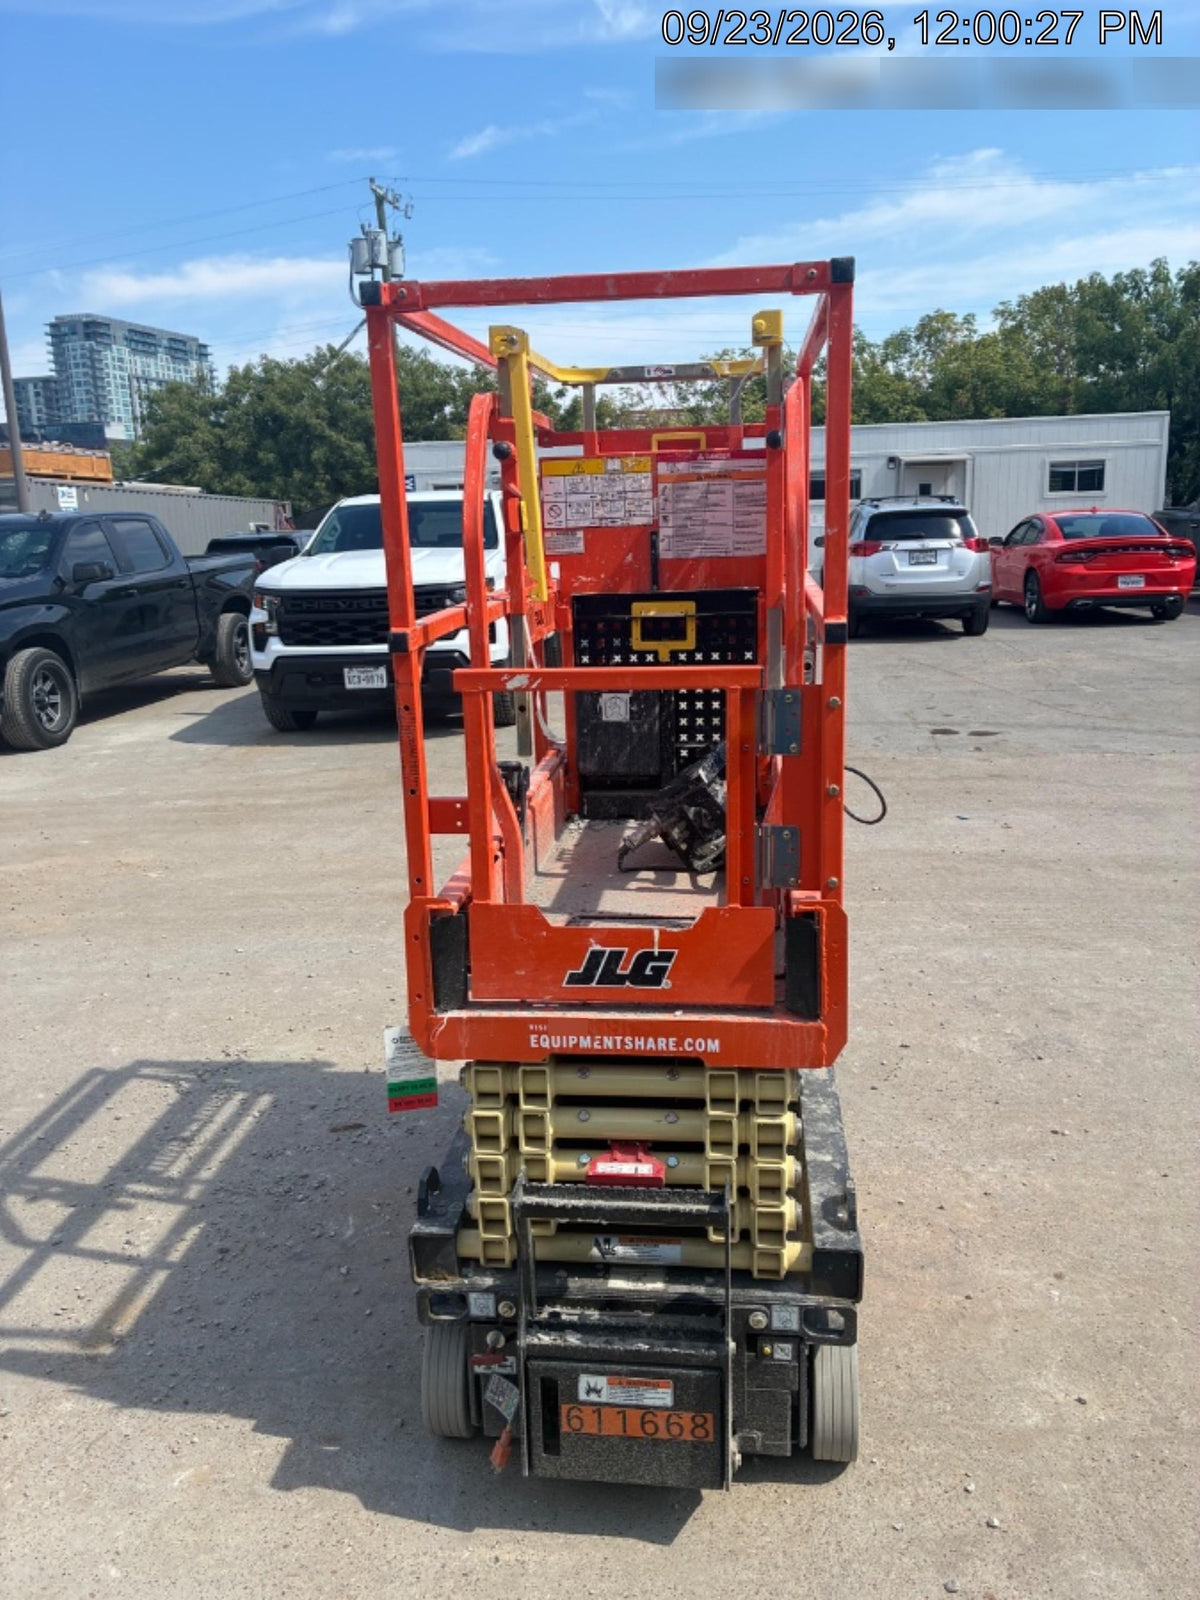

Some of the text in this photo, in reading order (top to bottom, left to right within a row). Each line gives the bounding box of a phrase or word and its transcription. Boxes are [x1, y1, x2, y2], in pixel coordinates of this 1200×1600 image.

[562, 947, 678, 988] JLG
[529, 1034, 721, 1053] EQUIPMENTSHARE.COM
[565, 1405, 710, 1439] 611668
